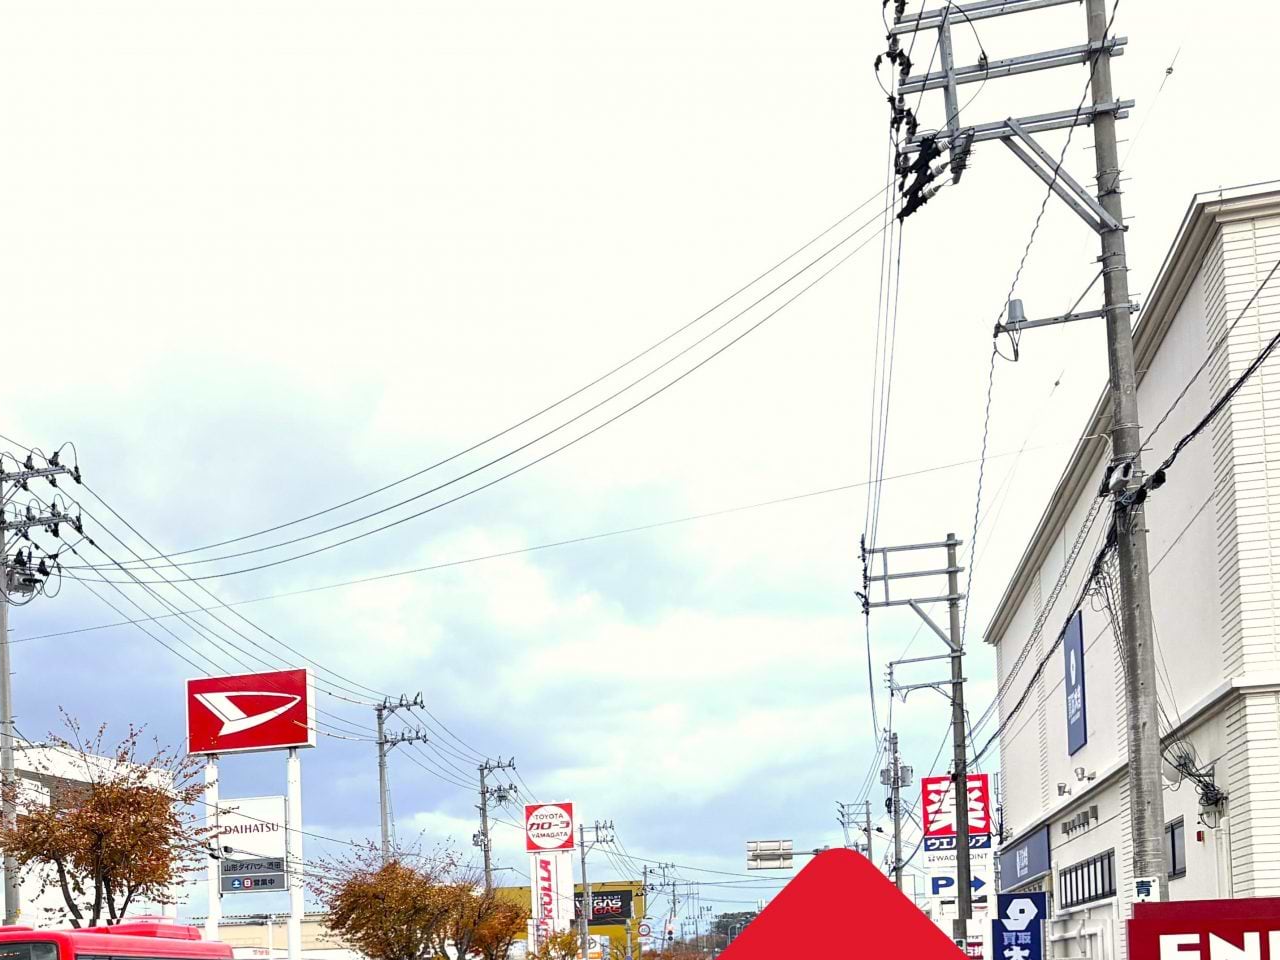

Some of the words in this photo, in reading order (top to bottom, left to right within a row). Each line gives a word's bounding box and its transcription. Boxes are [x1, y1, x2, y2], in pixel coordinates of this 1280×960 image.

[926, 780, 986, 832] 薬
[224, 823, 279, 834] DAIHATSU
[528, 820, 570, 831] カローラ
[932, 876, 955, 895] P
[575, 899, 622, 907] VGAS
[1002, 931, 1032, 945] 買取
